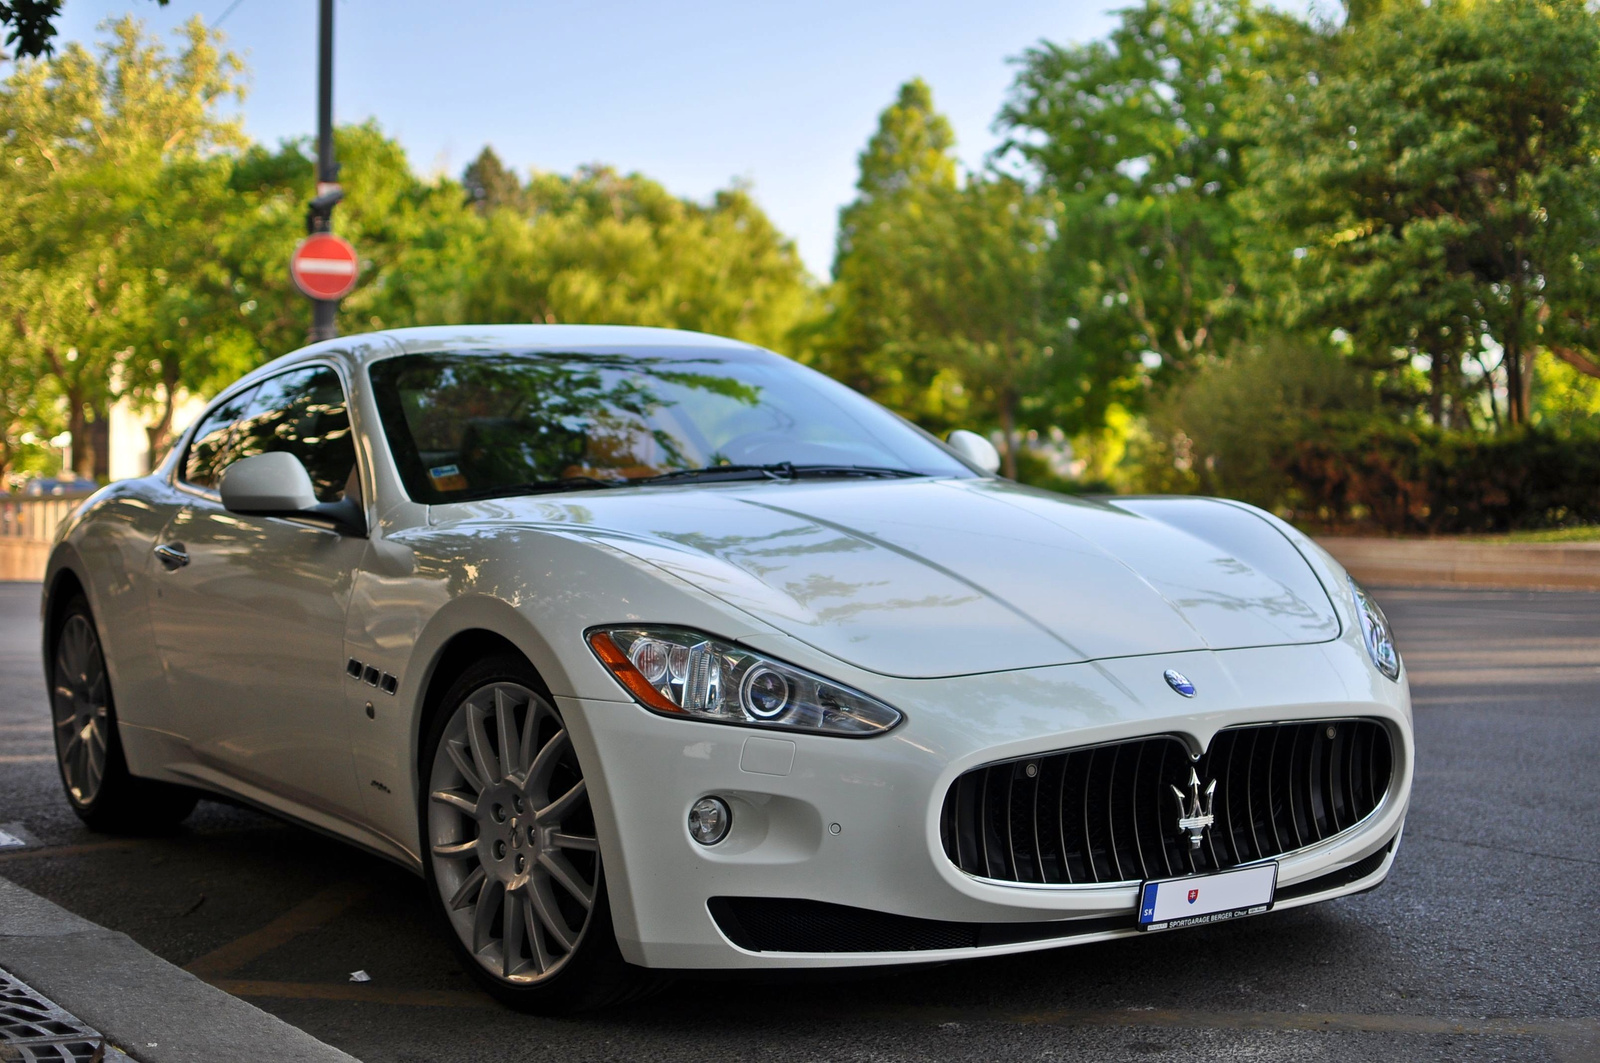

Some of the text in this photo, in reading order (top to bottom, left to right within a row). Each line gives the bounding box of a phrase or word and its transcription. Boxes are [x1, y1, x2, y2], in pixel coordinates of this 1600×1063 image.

[1144, 908, 1153, 916] SK
[1169, 916, 1210, 928] SPORTGARAGE
[1210, 911, 1233, 922] BERGER
